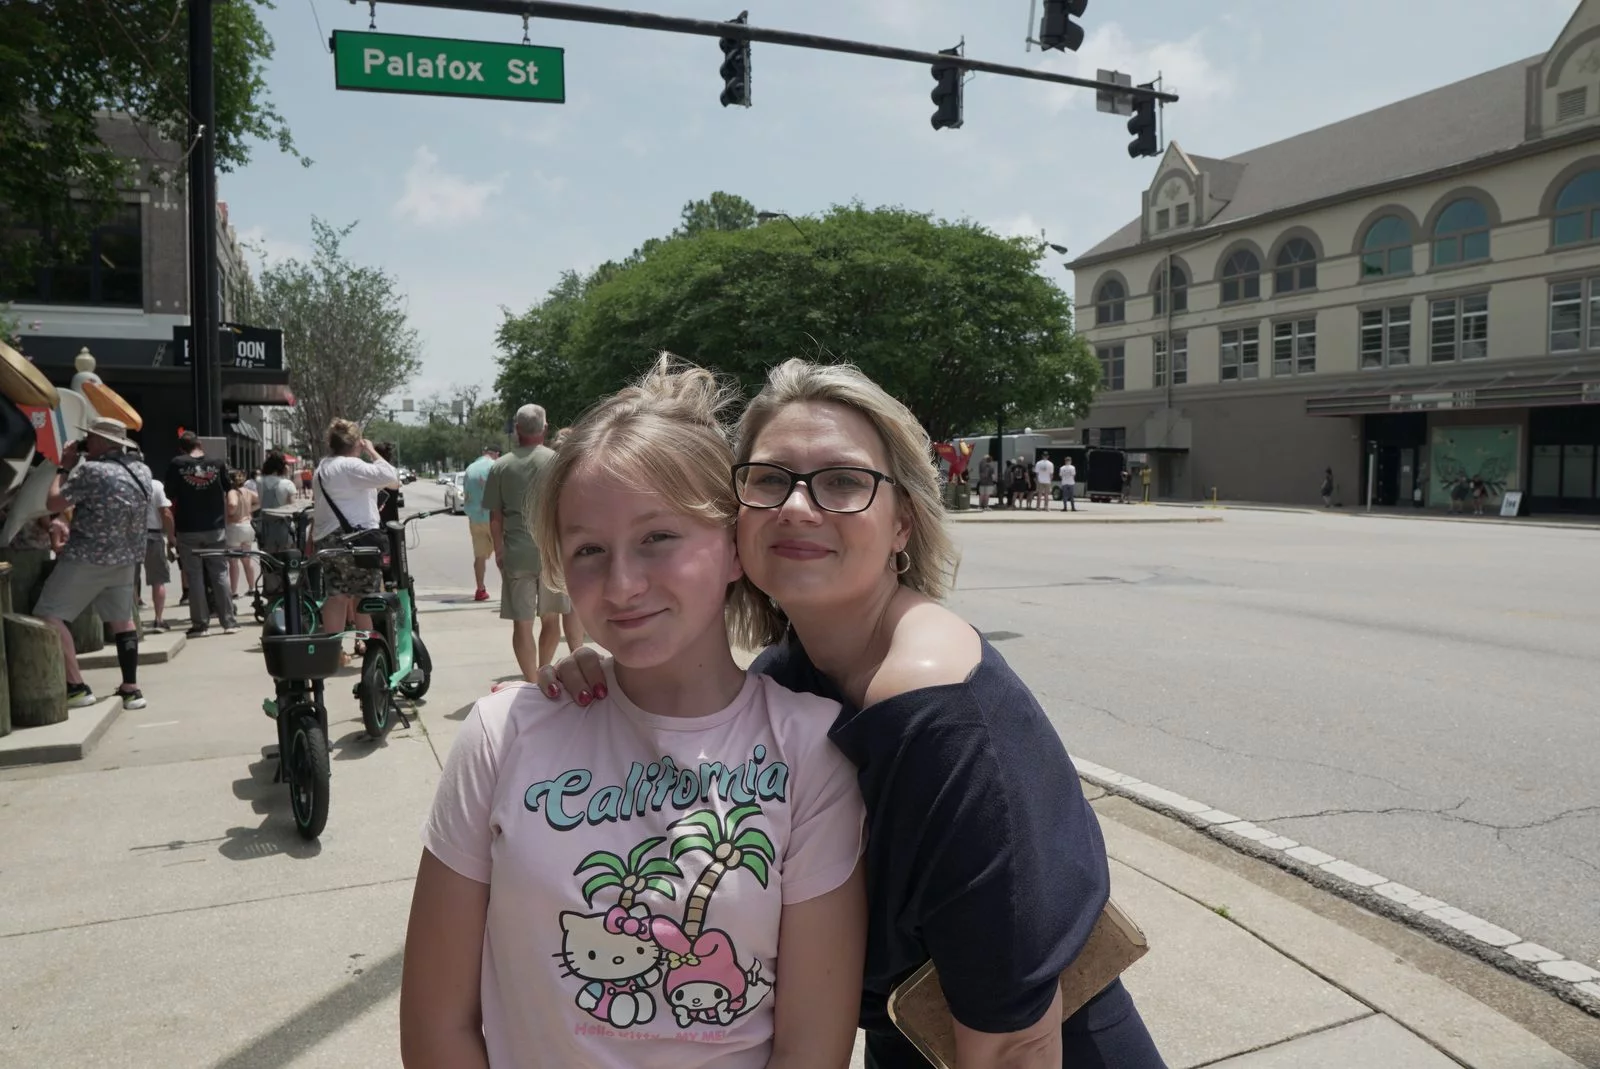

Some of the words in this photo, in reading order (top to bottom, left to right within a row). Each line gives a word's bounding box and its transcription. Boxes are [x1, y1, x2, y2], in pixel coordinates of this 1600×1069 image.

[363, 48, 484, 82] Palafox
[507, 58, 539, 85] St
[237, 341, 266, 360] OON
[524, 744, 789, 832] California
[575, 1022, 615, 1038] Hello
